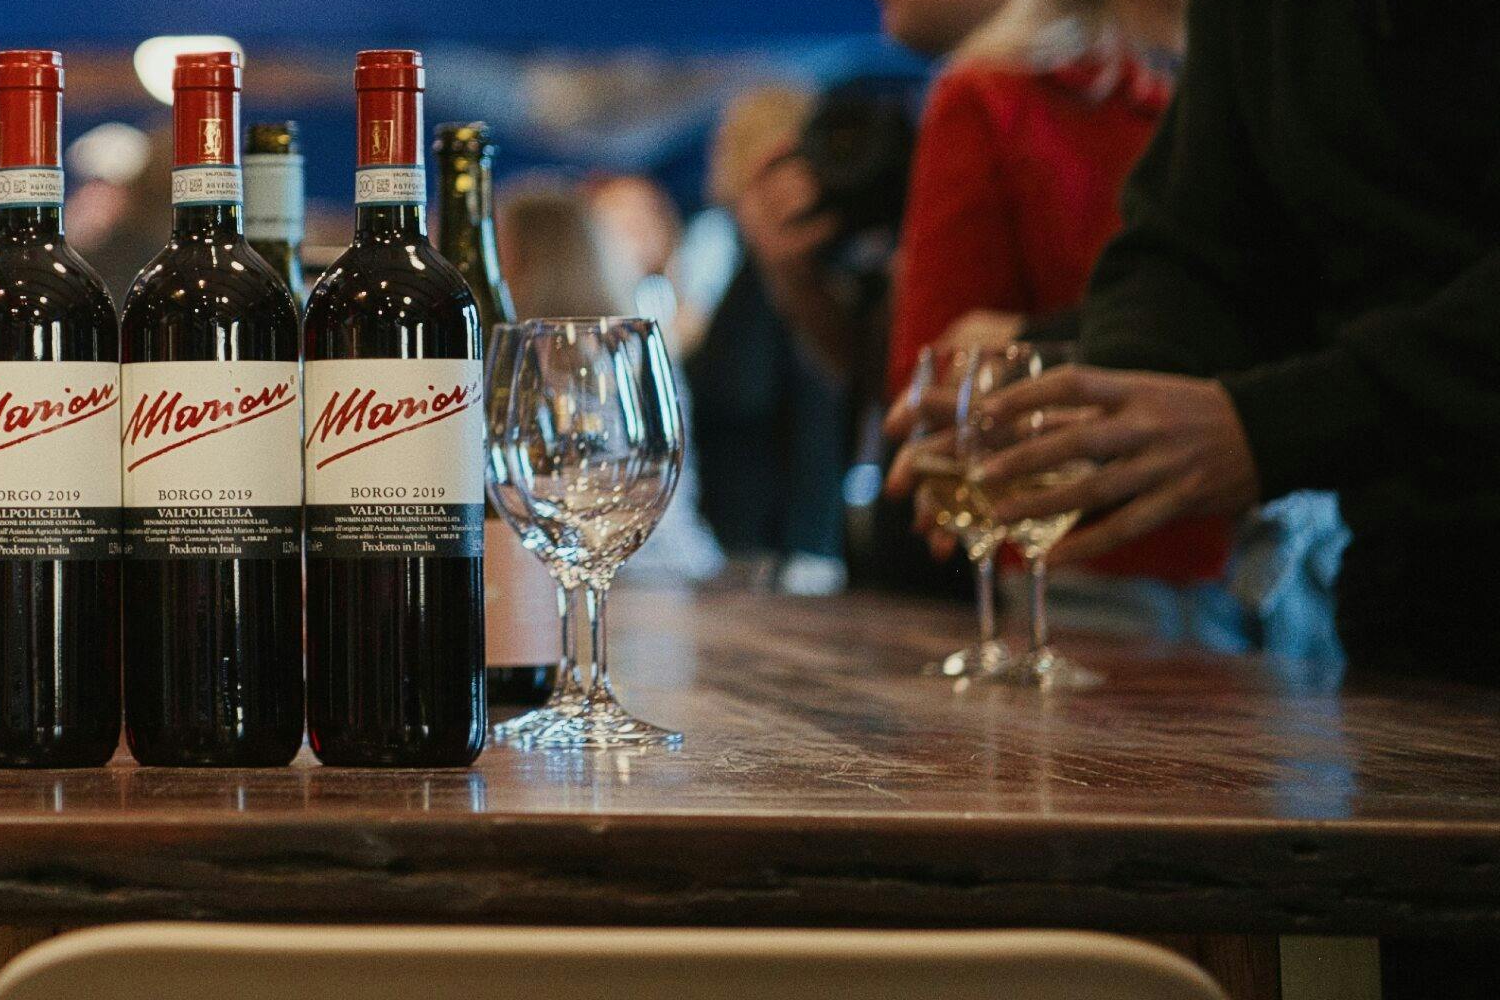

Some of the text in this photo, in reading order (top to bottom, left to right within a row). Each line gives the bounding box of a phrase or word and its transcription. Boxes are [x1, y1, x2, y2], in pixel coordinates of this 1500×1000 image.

[121, 382, 289, 446] Marion
[306, 382, 478, 449] Marion
[48, 490, 81, 501] 2019
[158, 490, 252, 500] BORGO 2019
[351, 487, 445, 498] BORGO 2019
[157, 508, 253, 518] VALPOLICELLA
[350, 505, 446, 516] VALPOLICELLA
[36, 545, 46, 555] in
[47, 544, 70, 555] Italia
[169, 543, 242, 554] Prodotto in Italia
[362, 540, 436, 552] Prodotto in Italia
